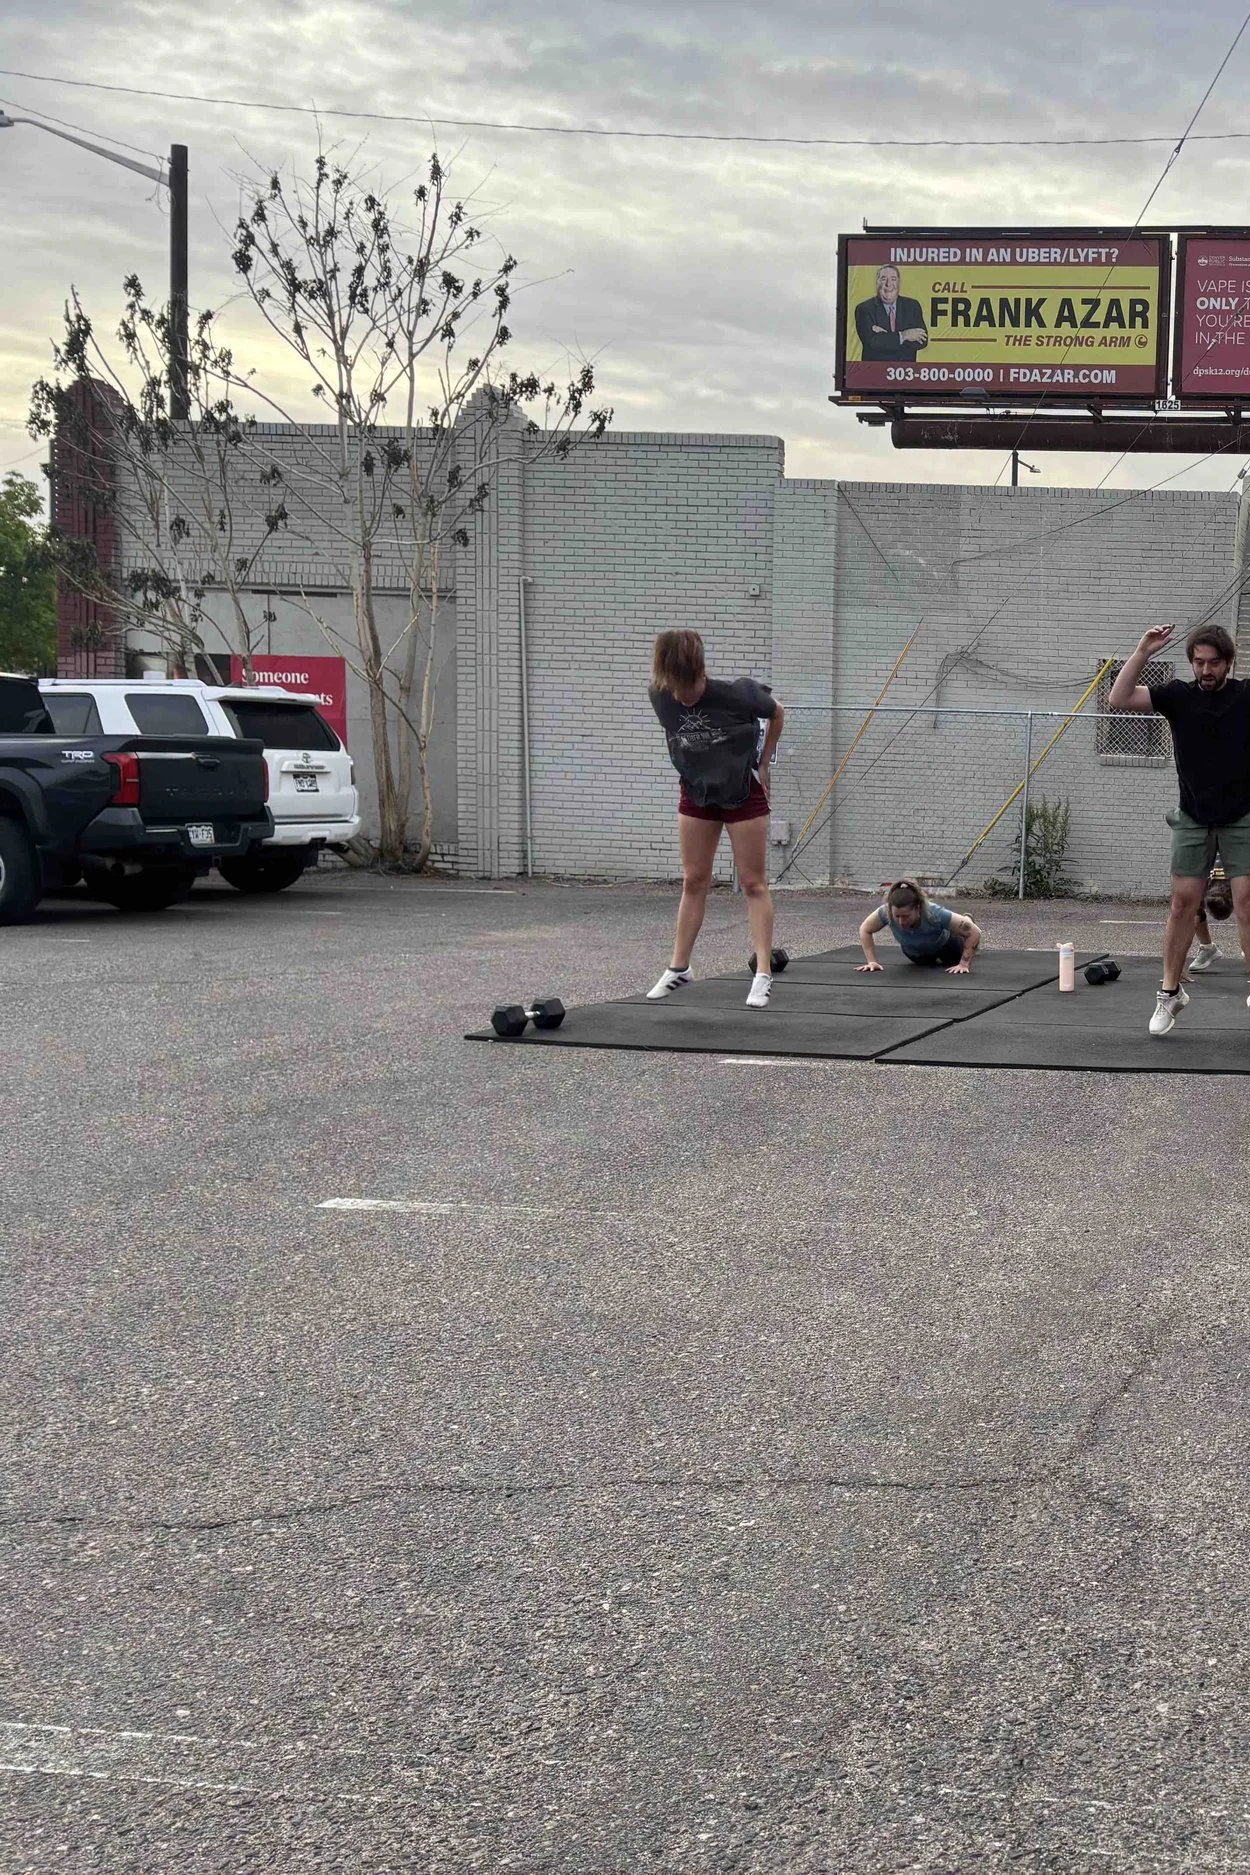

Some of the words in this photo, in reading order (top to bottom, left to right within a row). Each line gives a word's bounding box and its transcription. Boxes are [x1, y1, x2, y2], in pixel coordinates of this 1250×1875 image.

[890, 247, 961, 263] INJURED
[965, 247, 983, 263] IN
[987, 247, 1011, 263] AN
[1015, 247, 1119, 264] UBER/LYFT?
[931, 281, 968, 294] CALL
[1196, 279, 1237, 293] VAPE
[1196, 297, 1240, 311] ONLY
[929, 297, 1049, 329] FRANK
[1053, 297, 1151, 330] AZAR
[1003, 334, 1033, 347] THE
[1037, 334, 1095, 348] STRONG
[1097, 334, 1132, 348] ARM
[1194, 332, 1210, 345] IN
[1214, 332, 1246, 346] THE
[886, 367, 994, 382] 303-800-0000
[1008, 368, 1116, 384] FDAZAR.COM
[1155, 400, 1180, 410] 1625
